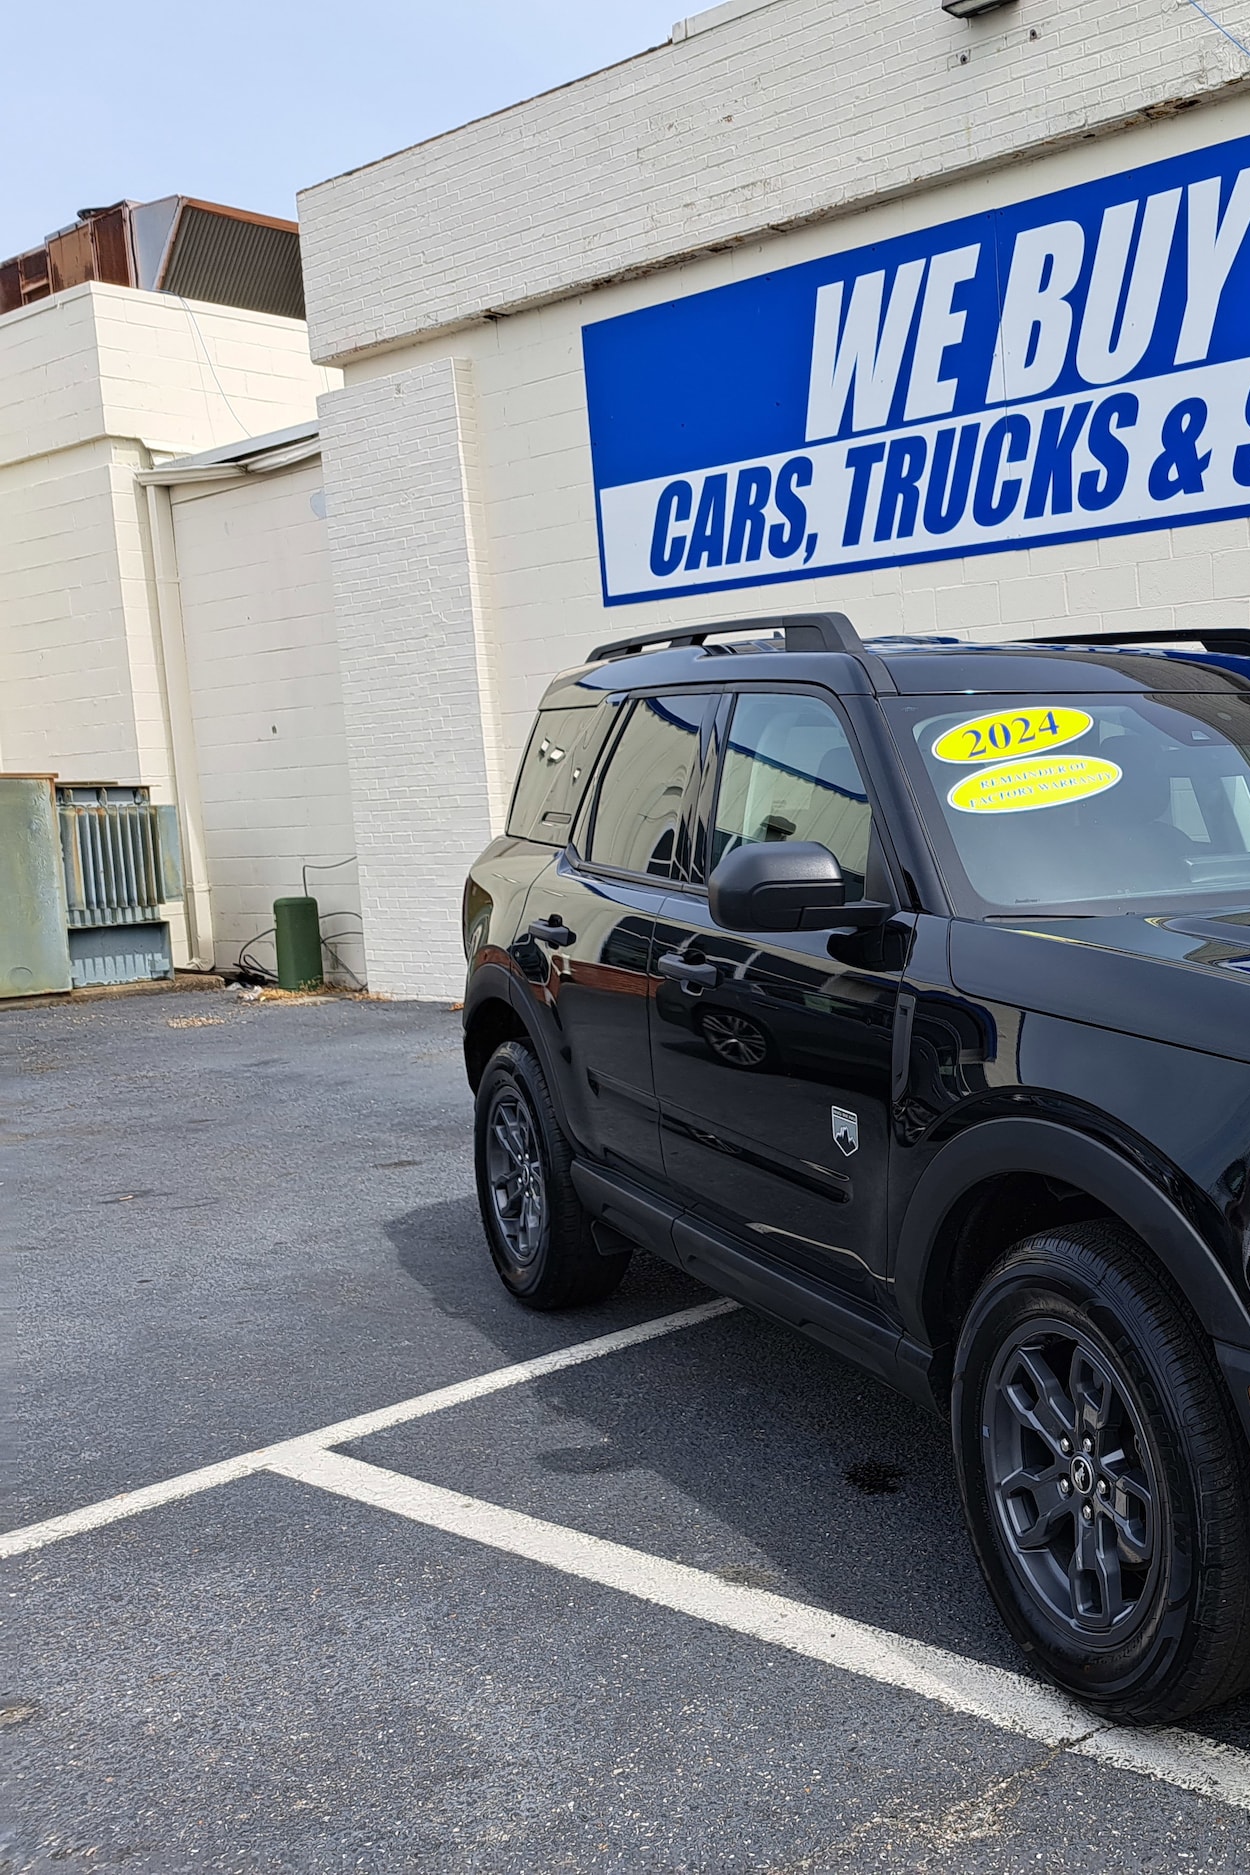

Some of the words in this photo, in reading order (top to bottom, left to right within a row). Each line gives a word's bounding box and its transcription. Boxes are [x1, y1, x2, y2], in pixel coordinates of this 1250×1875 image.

[806, 244, 980, 441] WE
[649, 457, 818, 577] CARS,
[842, 393, 1139, 546] TRUCKS
[1149, 398, 1211, 500] &
[962, 710, 1060, 758] 2024
[969, 786, 1035, 808] FACTORY
[1038, 771, 1113, 792] WARRANTY
[980, 763, 1067, 789] REMAINDER
[1070, 761, 1089, 772] OF
